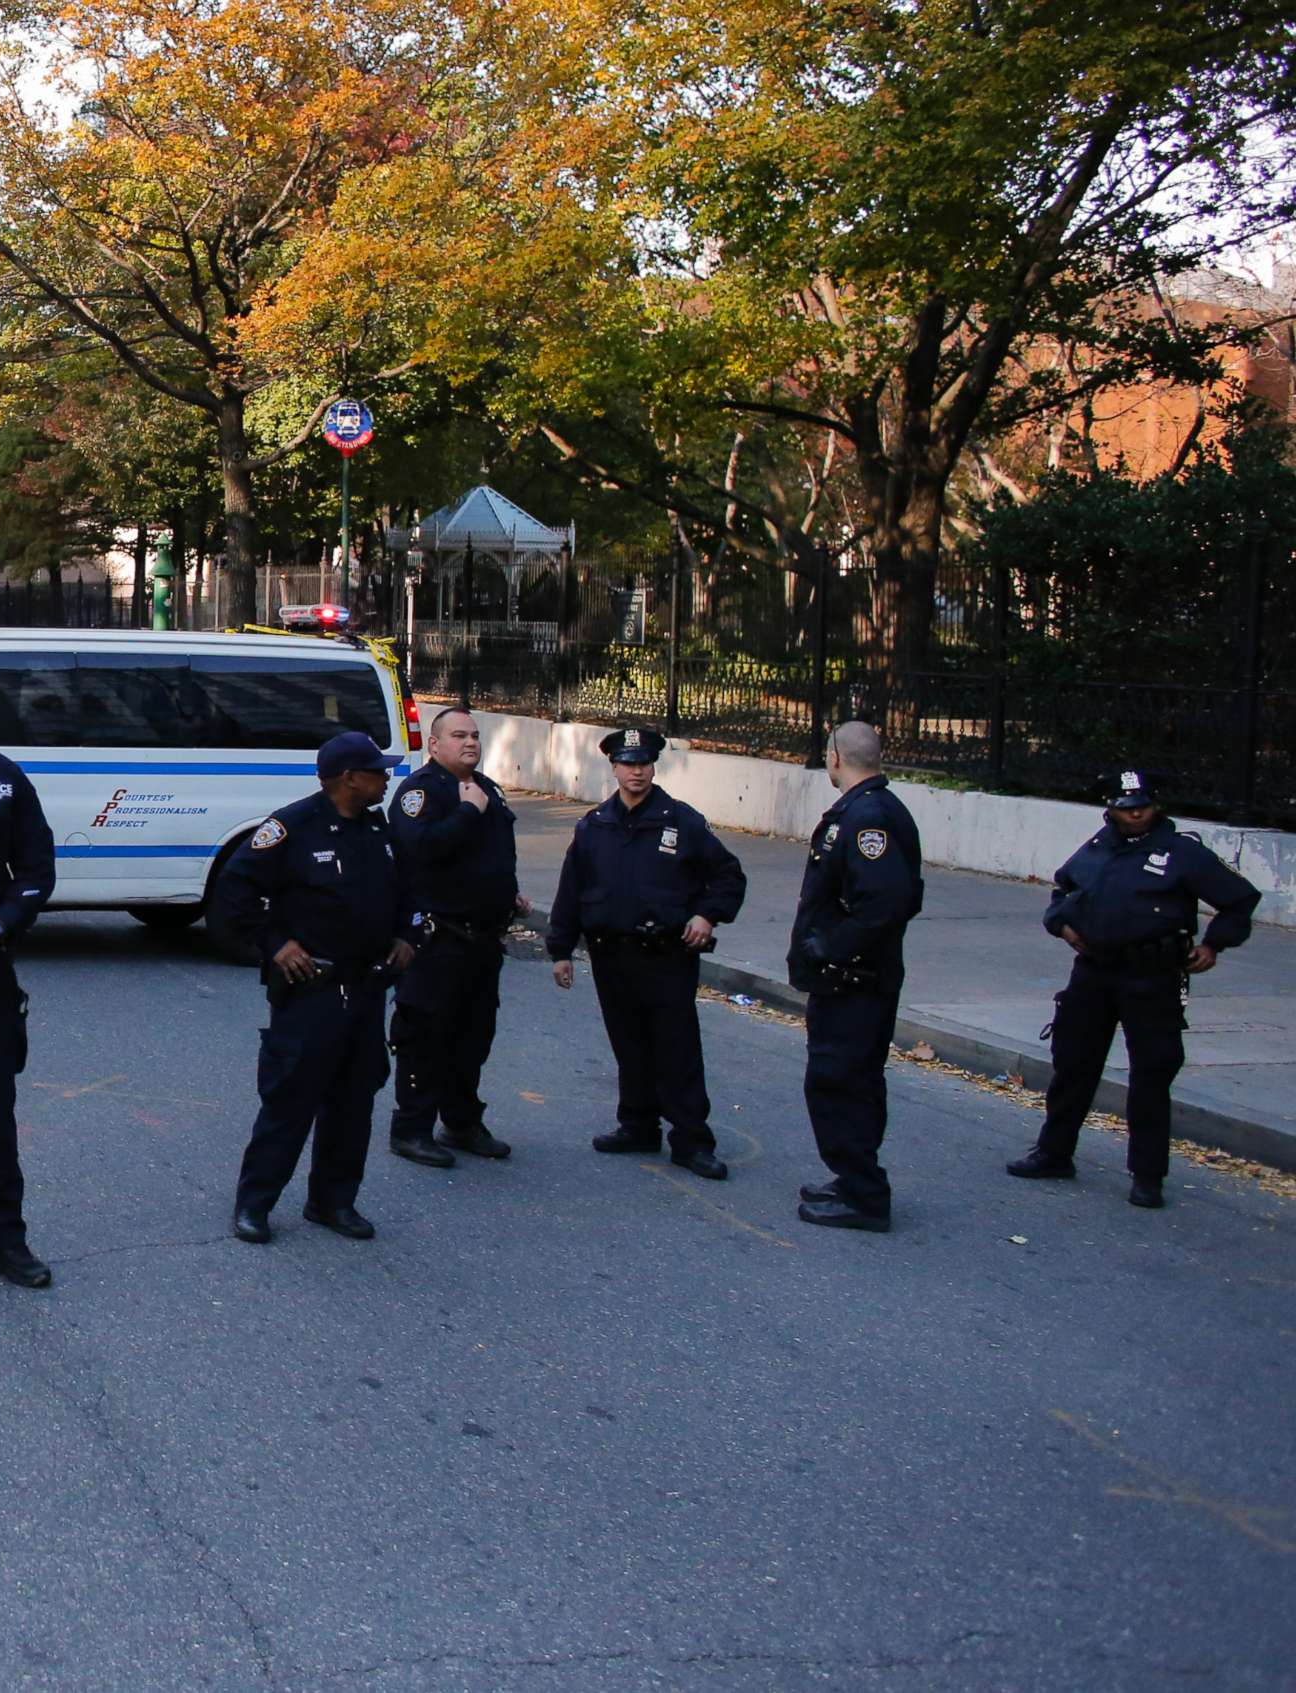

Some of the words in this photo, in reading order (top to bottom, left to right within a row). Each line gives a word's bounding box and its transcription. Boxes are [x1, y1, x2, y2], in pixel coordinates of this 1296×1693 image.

[111, 789, 175, 802] COURTESY
[102, 802, 209, 815] PROFESSIONALISM
[90, 815, 148, 828] RESPECT
